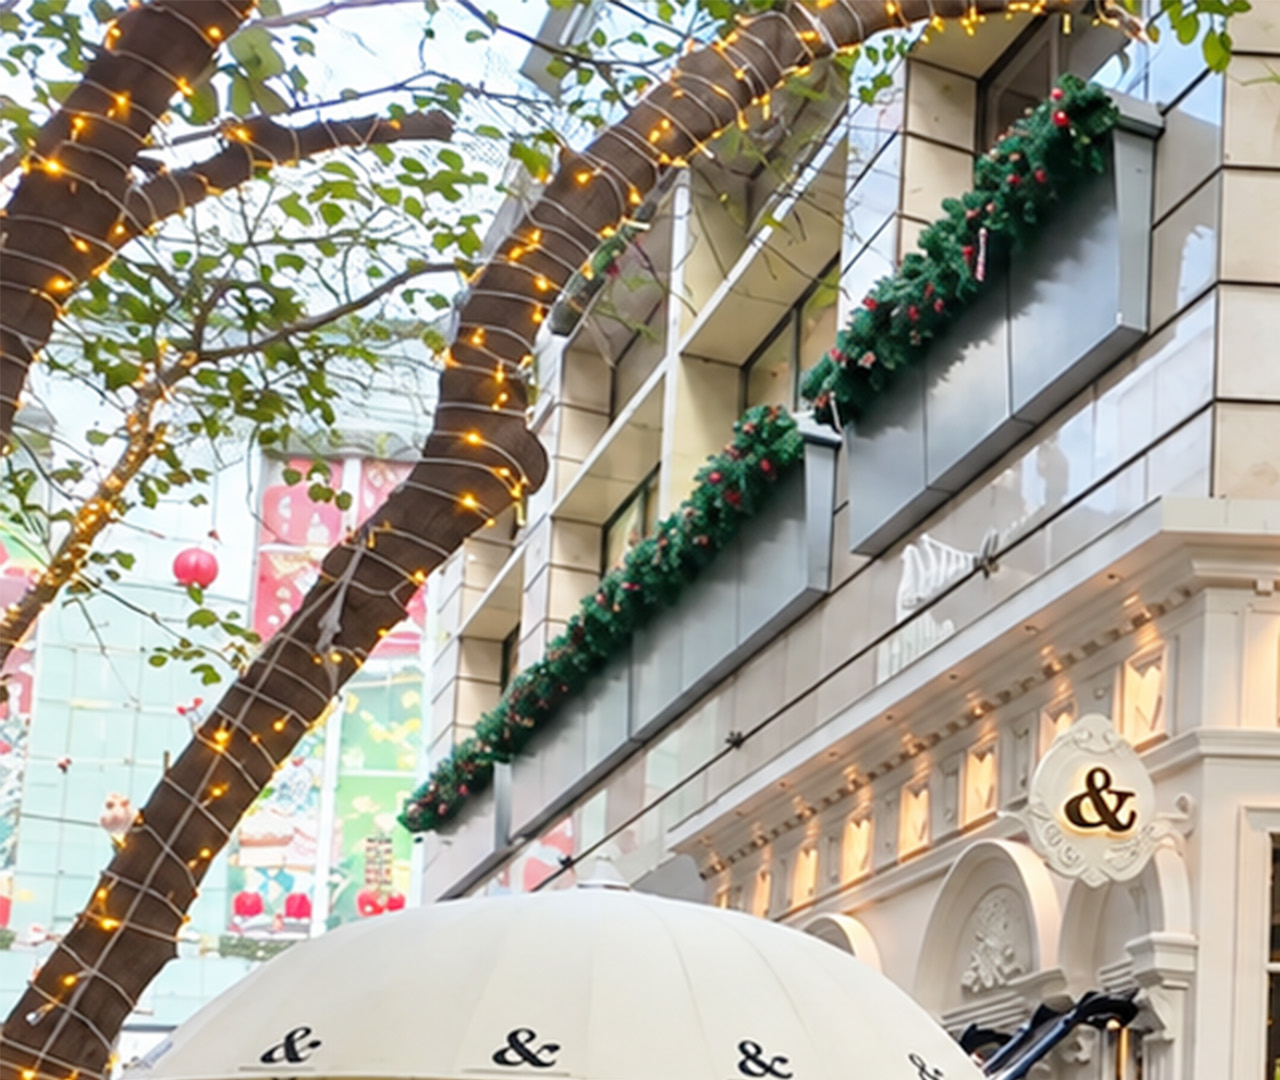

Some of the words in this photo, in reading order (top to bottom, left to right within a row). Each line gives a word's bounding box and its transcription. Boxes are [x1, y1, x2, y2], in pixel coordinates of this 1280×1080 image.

[1064, 766, 1137, 832] &
[260, 1027, 322, 1063] &
[492, 1028, 560, 1067] &
[738, 1040, 793, 1080] &
